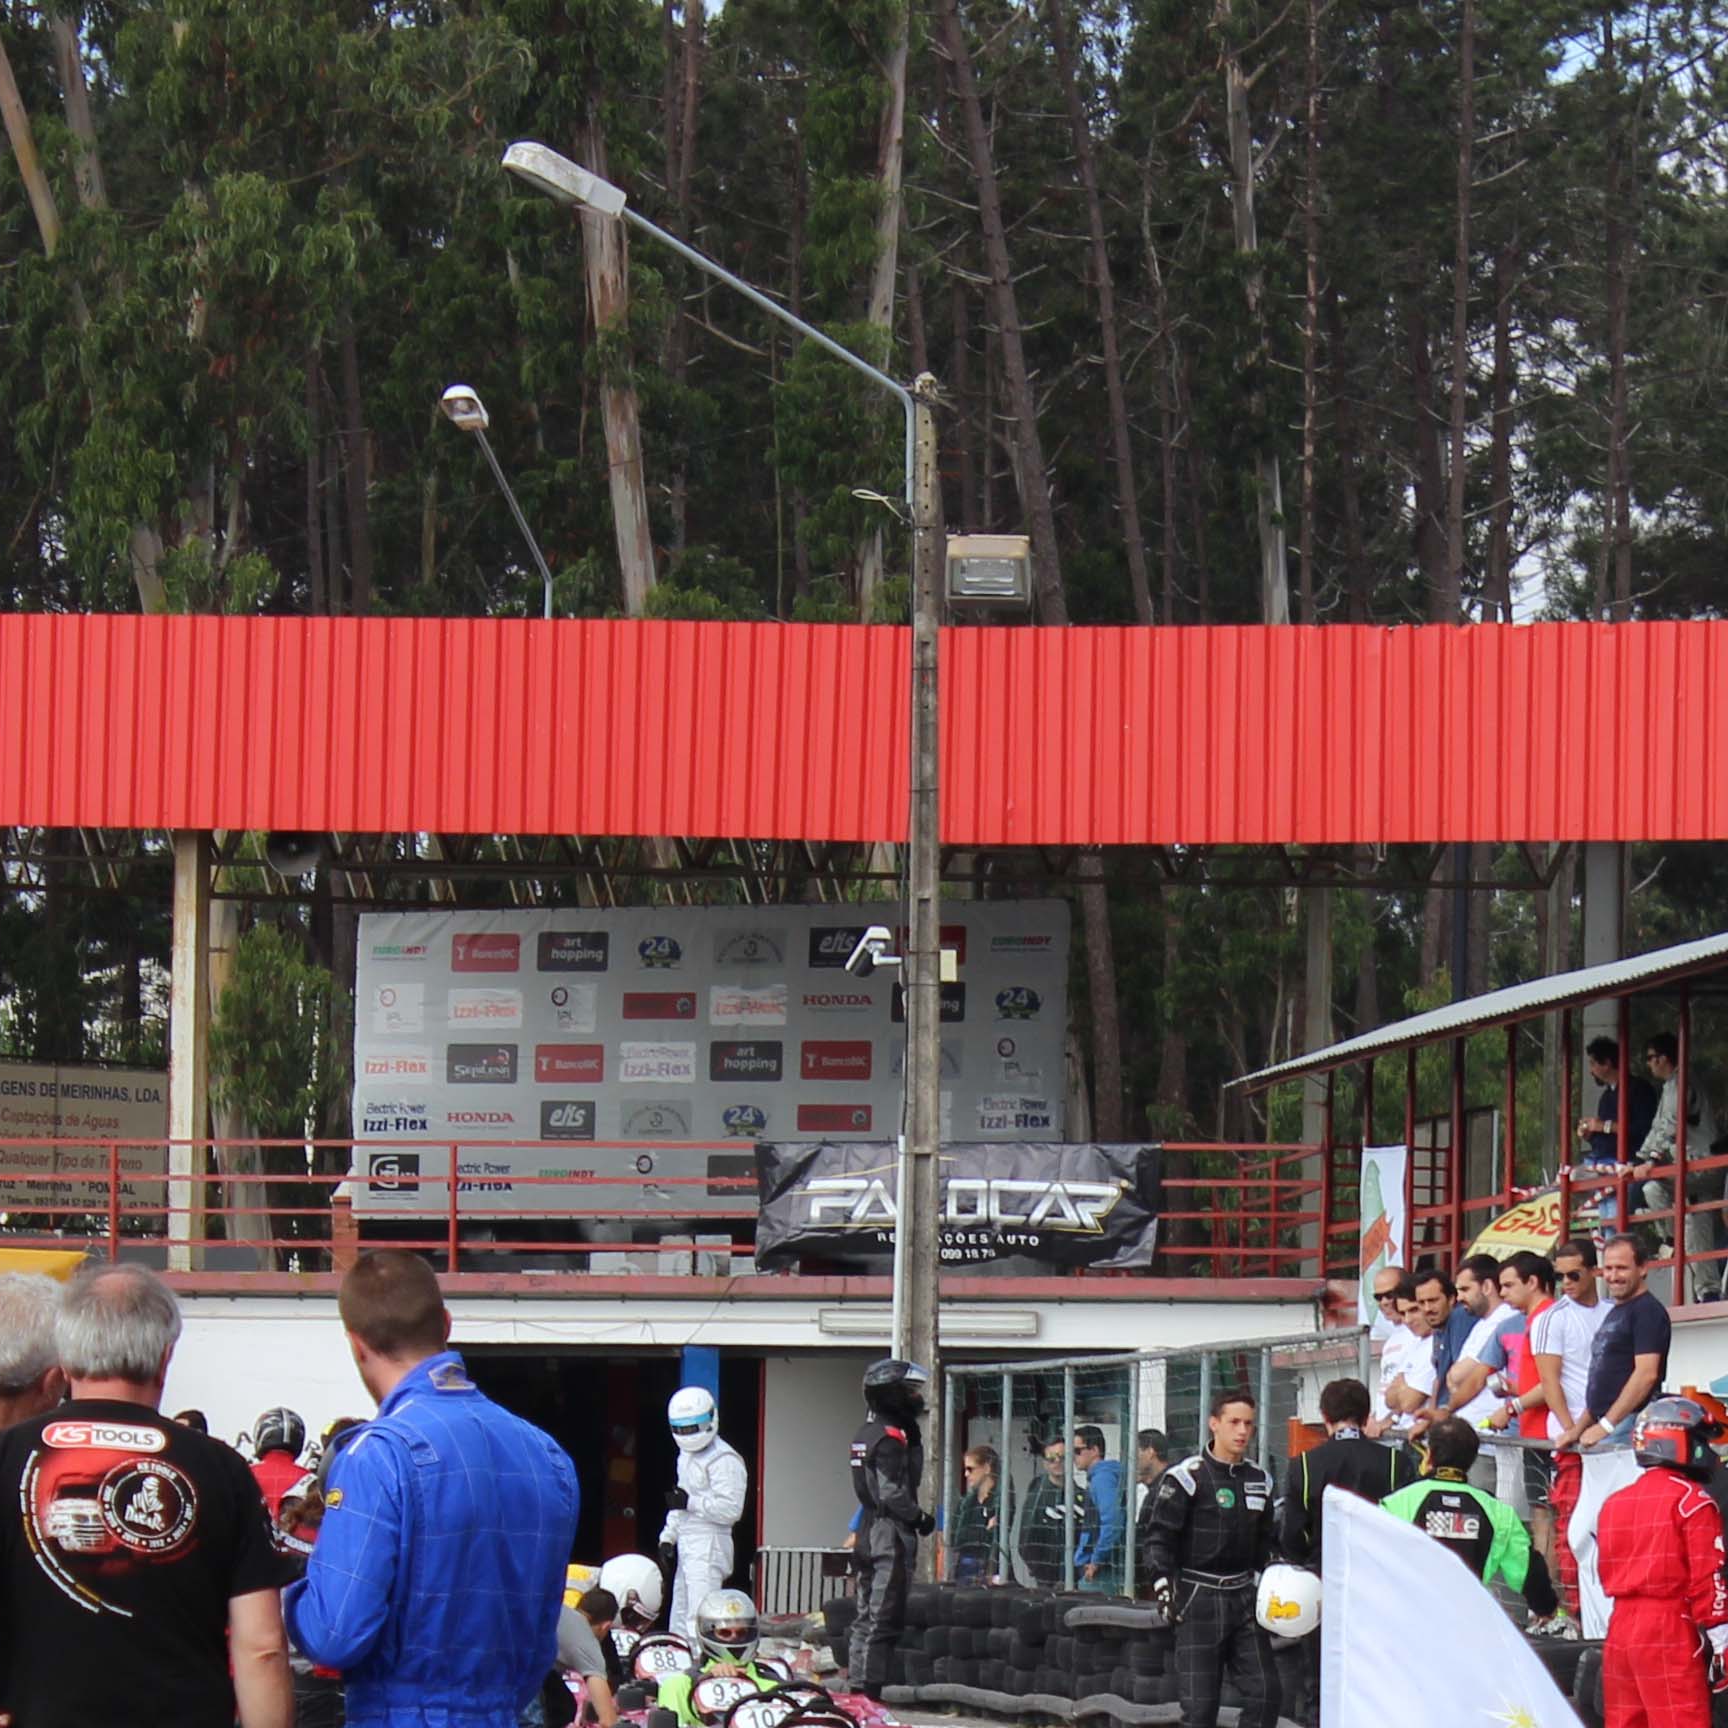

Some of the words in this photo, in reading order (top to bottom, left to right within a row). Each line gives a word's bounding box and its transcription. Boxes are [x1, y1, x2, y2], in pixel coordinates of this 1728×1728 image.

[643, 938, 671, 954] 24
[802, 995, 873, 1006] HONDA
[39, 1081, 58, 1098] DE
[365, 1102, 399, 1115] Electric
[399, 1102, 427, 1114] Power
[728, 1107, 756, 1123] 24
[65, 1113, 81, 1126] de
[363, 1117, 428, 1132] Izzi-Flex
[446, 1111, 515, 1123] HONDA
[979, 1113, 1051, 1129] Izzi-Flex
[54, 1152, 78, 1171] Tipo
[79, 1155, 95, 1169] de
[806, 1178, 1122, 1230] PAOCAR
[51, 1425, 90, 1444] KS
[93, 1427, 156, 1447] TOOLS
[654, 1650, 678, 1669] 88
[712, 1683, 742, 1704] 93
